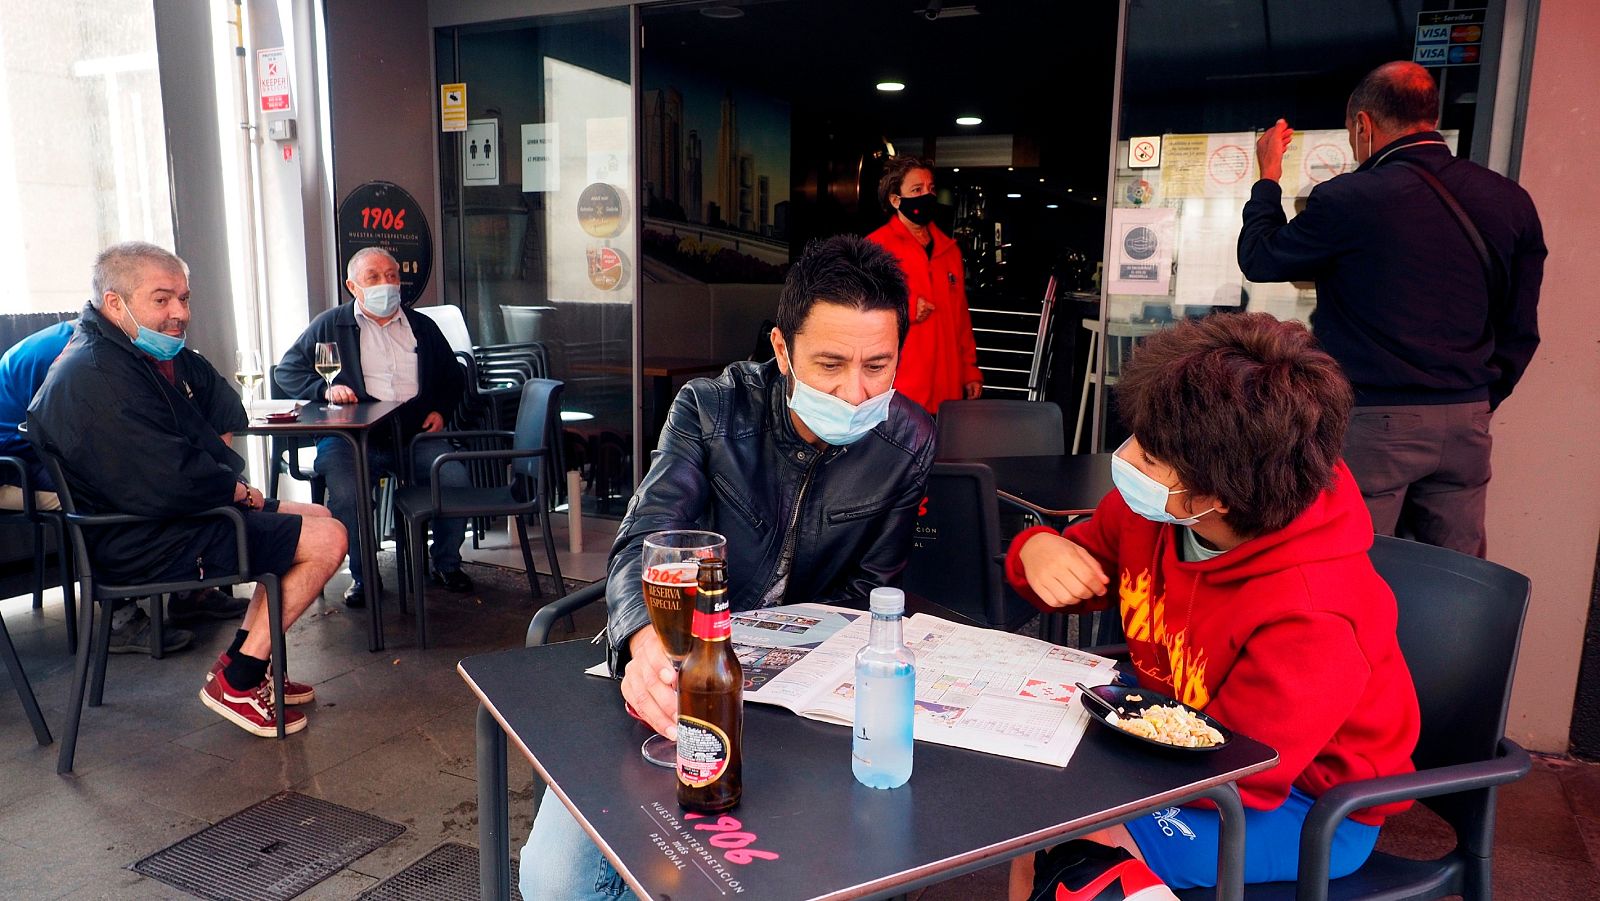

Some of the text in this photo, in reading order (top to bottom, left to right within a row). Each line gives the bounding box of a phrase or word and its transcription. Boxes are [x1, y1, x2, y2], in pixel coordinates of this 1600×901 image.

[1422, 28, 1448, 38] VISA
[1419, 48, 1445, 58] VISA
[362, 208, 405, 230] 1906
[647, 566, 683, 584] 1906
[649, 586, 681, 599] RESERVA
[650, 597, 681, 610] ESPECIAL
[651, 801, 682, 831] NUESTRA
[680, 831, 745, 894] INTERPRETACIÓN
[685, 813, 779, 864] 906
[650, 832, 687, 871] PERSONAL
